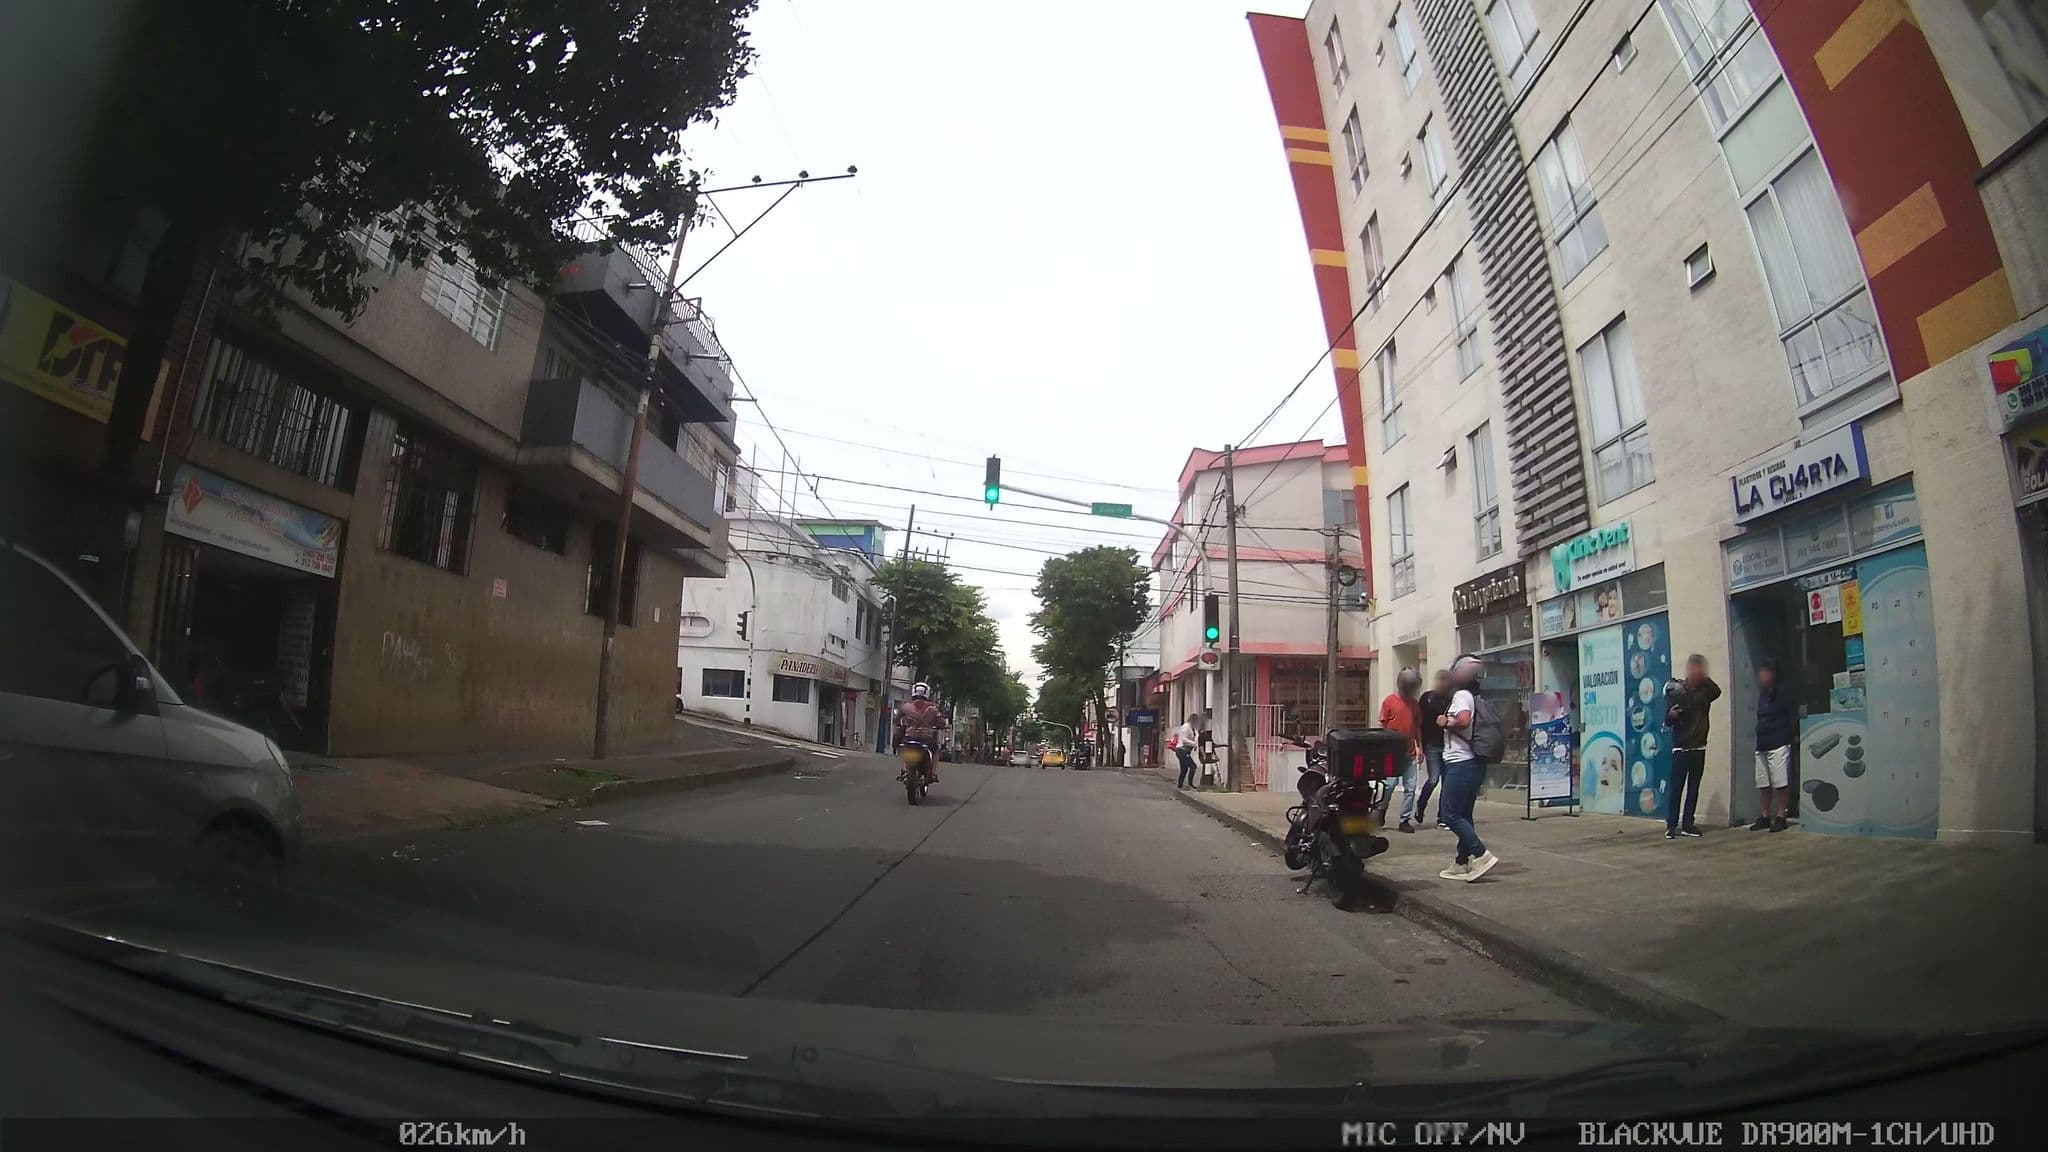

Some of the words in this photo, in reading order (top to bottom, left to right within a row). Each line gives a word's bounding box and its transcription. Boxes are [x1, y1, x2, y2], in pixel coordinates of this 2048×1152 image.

[1730, 475, 1764, 515] LA
[1583, 670, 1619, 689] VALORACIÓN
[1584, 692, 1597, 705] SIN
[1585, 705, 1618, 727] COSTO
